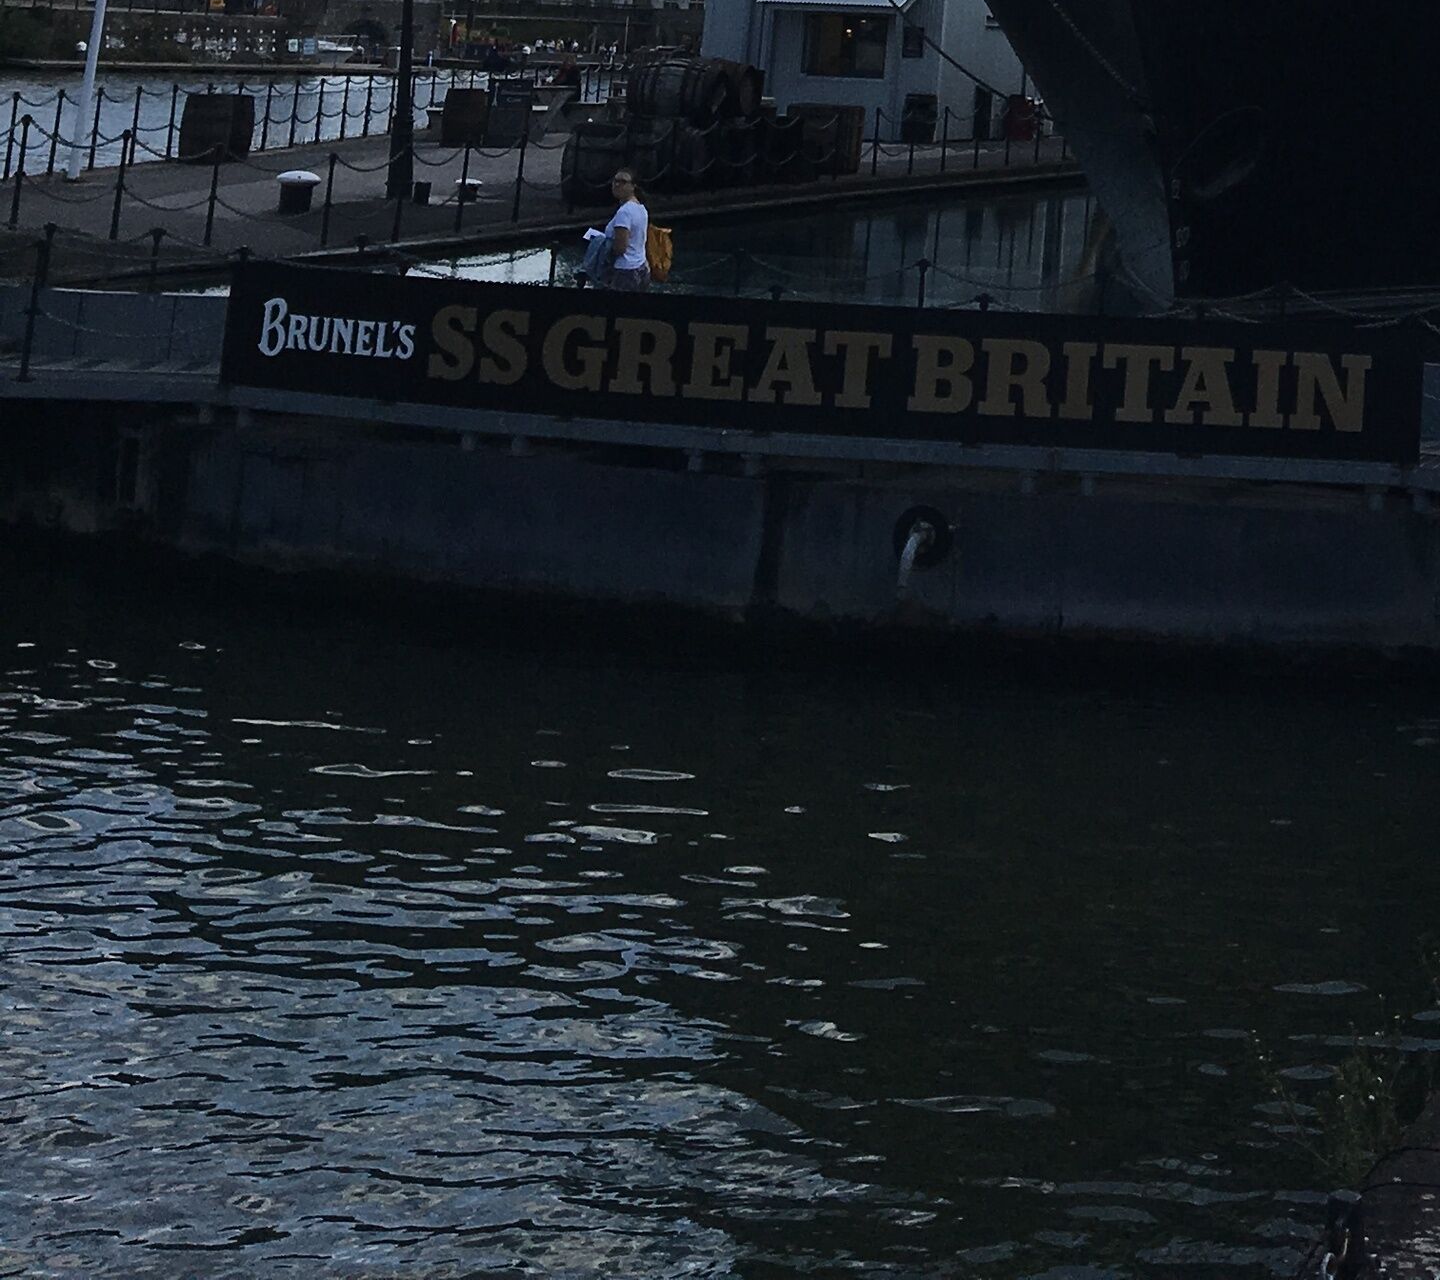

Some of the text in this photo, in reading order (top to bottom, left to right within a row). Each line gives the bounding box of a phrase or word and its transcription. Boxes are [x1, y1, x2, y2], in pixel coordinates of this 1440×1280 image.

[257, 297, 1372, 433] BRUNEL'S SS GREAT BRITAIN
